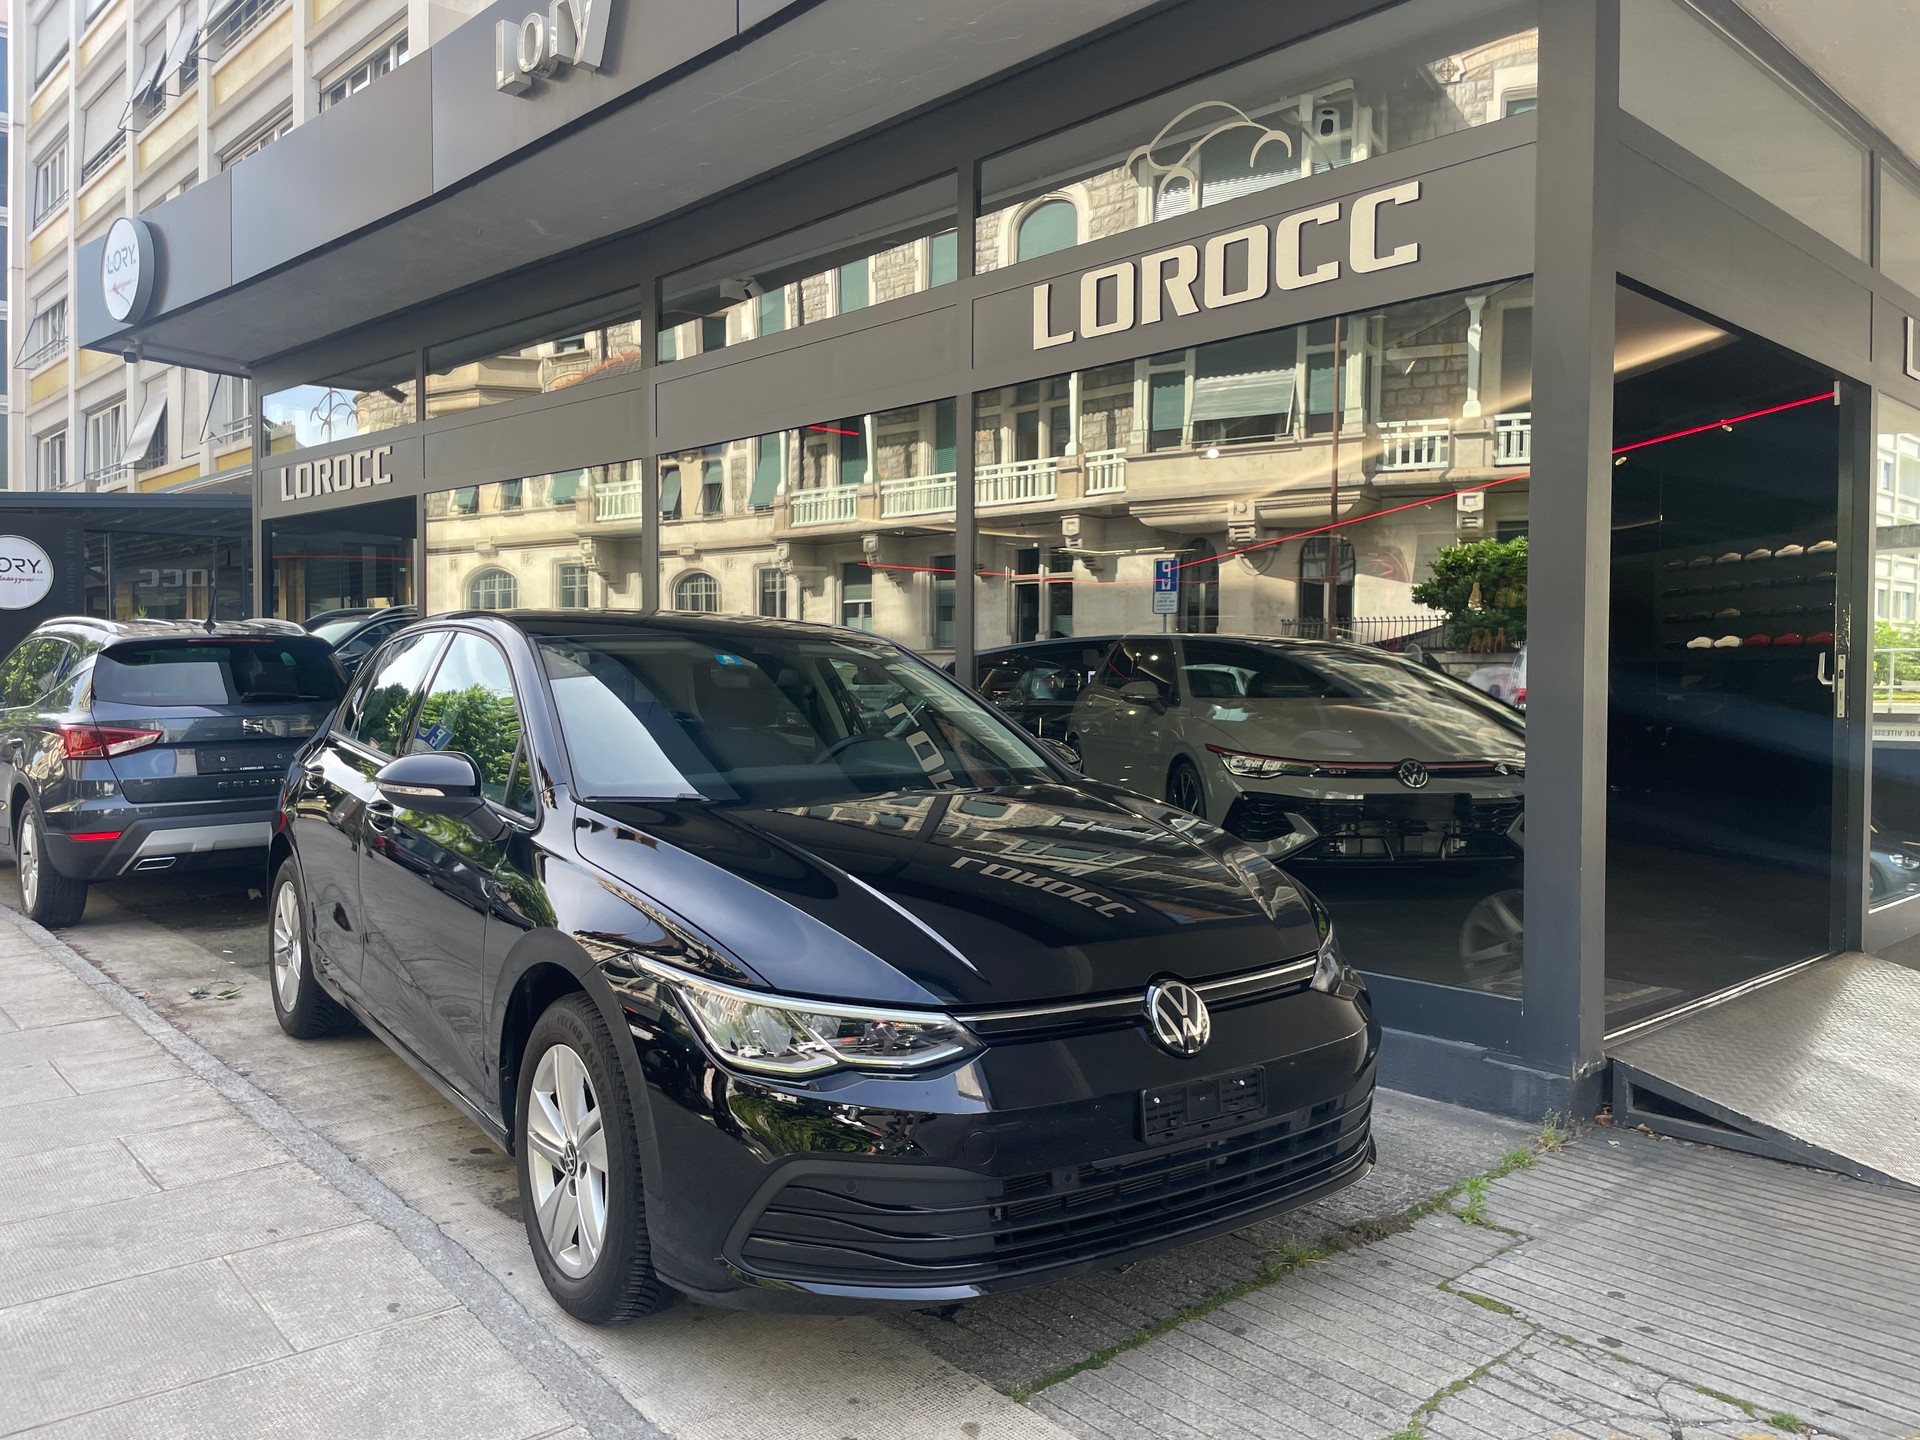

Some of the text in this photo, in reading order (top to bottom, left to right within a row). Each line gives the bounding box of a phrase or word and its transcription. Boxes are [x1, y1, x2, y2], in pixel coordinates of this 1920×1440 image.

[107, 243, 136, 274] LORY
[1033, 181, 1420, 350] LOROCC
[281, 445, 392, 501] LOROCC
